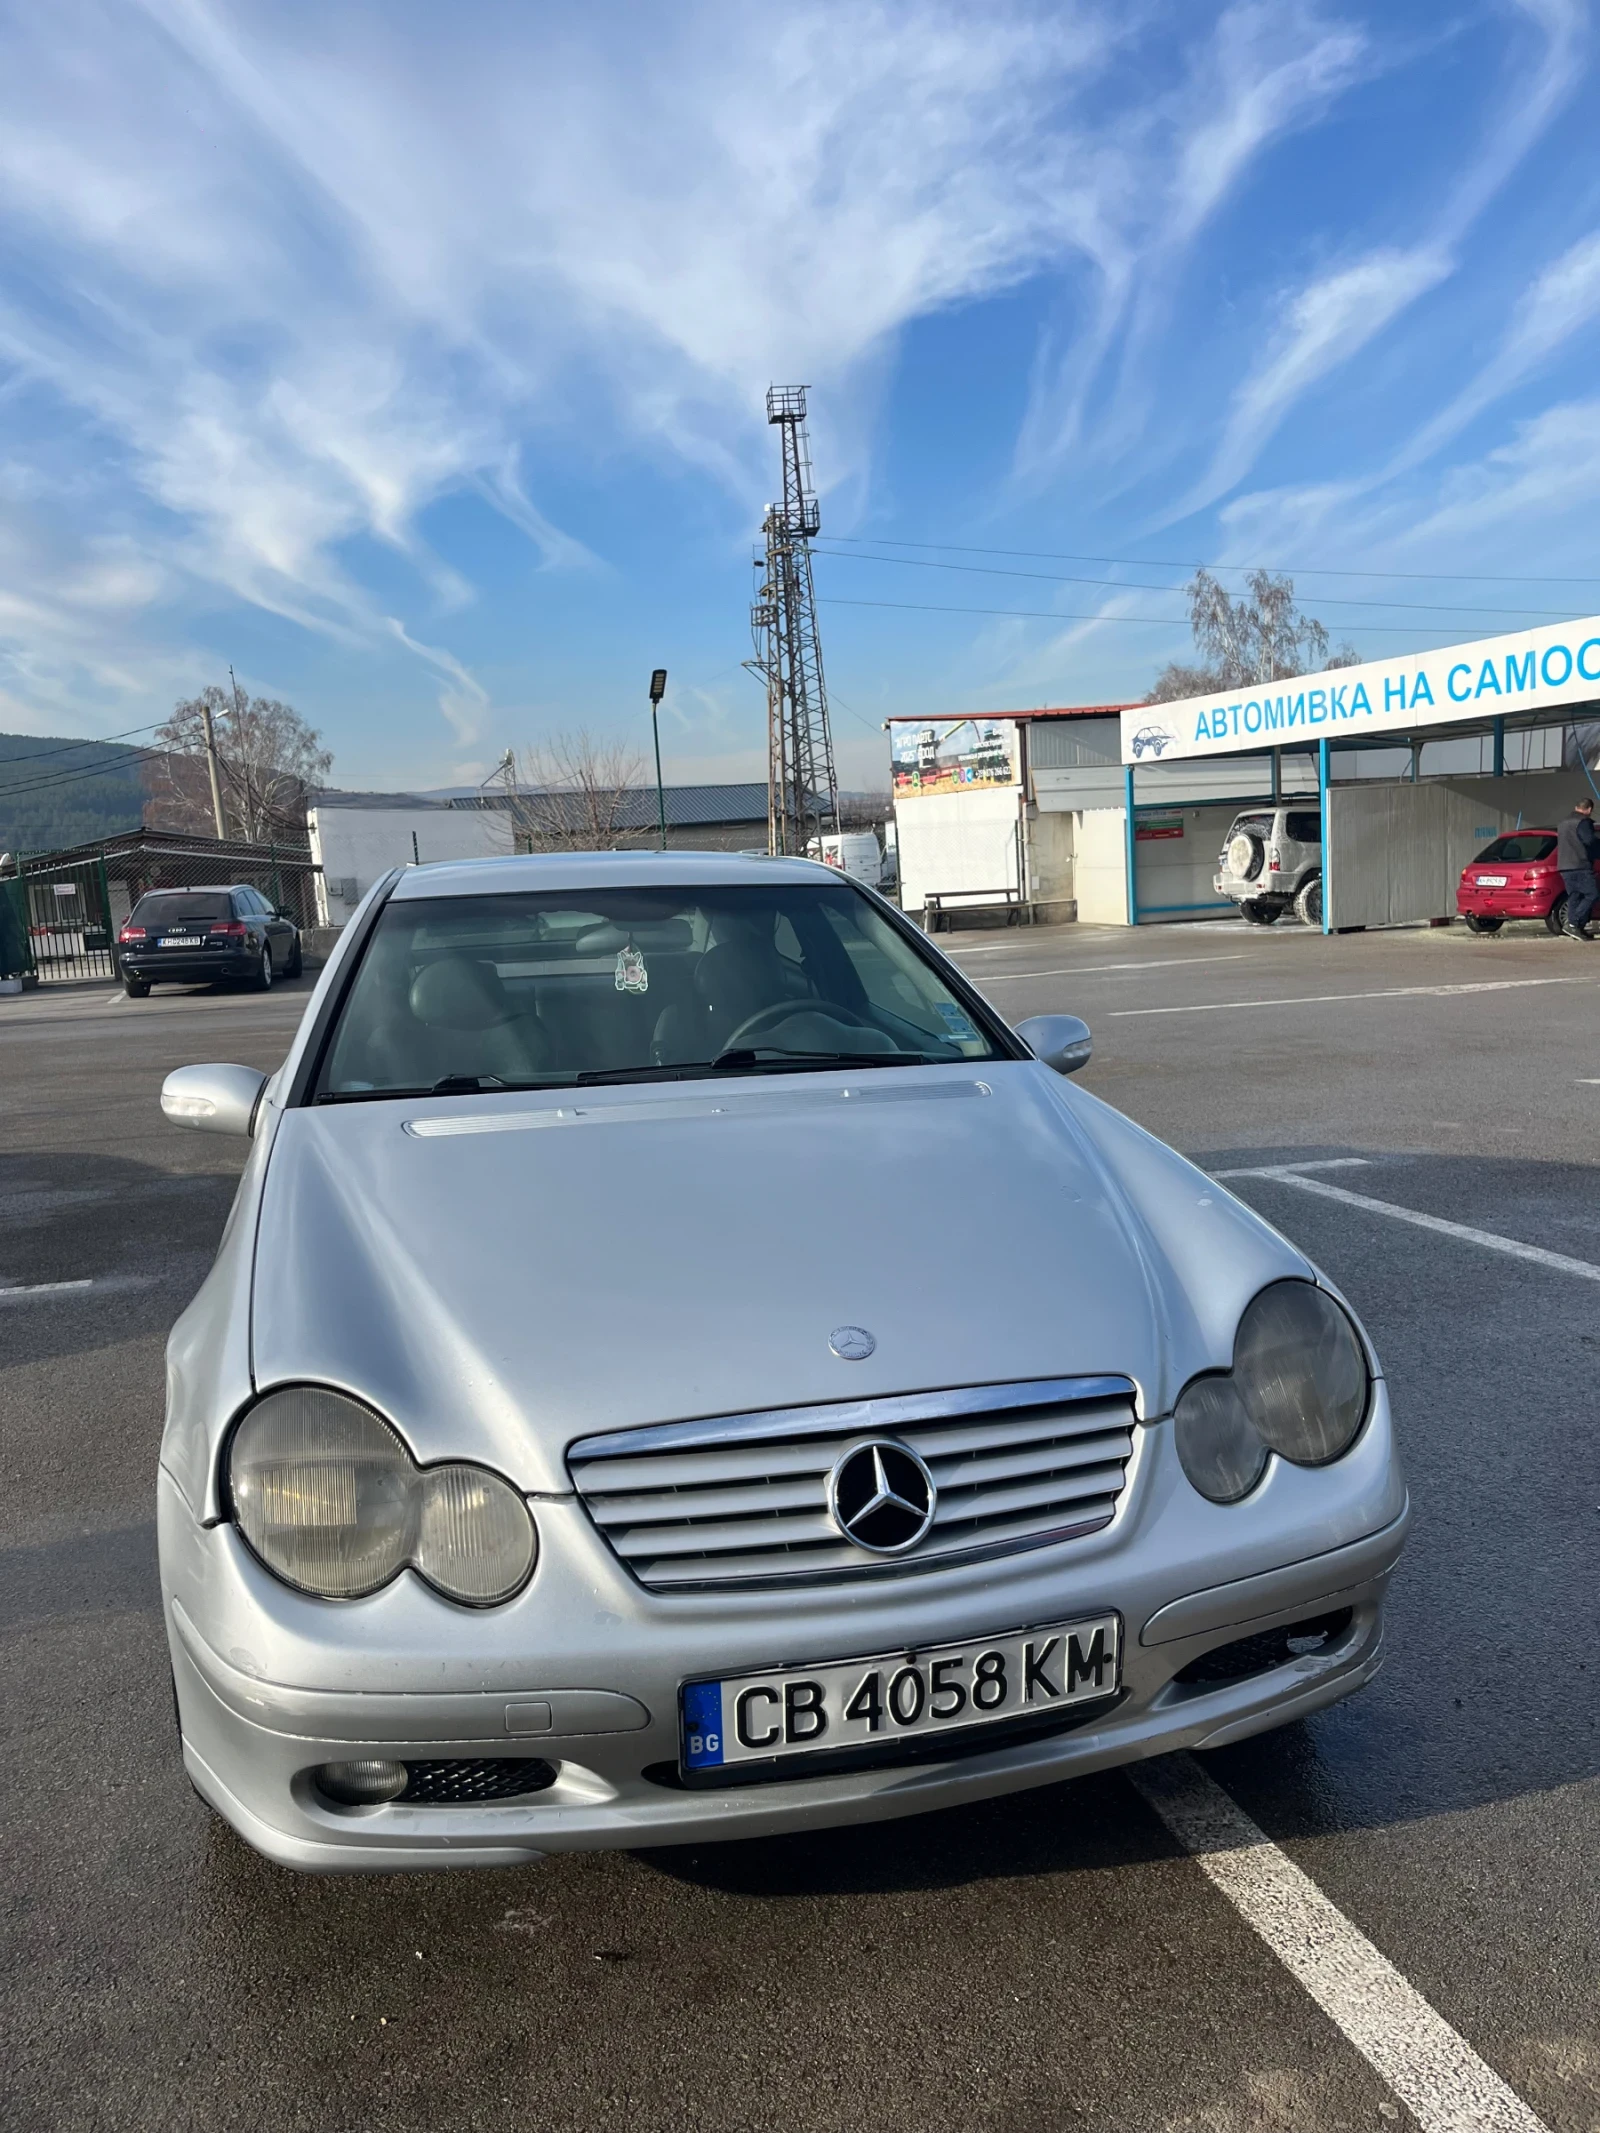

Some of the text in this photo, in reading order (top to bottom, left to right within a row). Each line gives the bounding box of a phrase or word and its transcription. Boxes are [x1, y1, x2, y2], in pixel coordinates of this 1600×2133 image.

[1194, 682, 1372, 741] АВТОМИВКА
[1384, 671, 1435, 712] НА
[735, 1628, 1105, 1749] CB 4058 KM
[690, 1734, 719, 1755] BG
